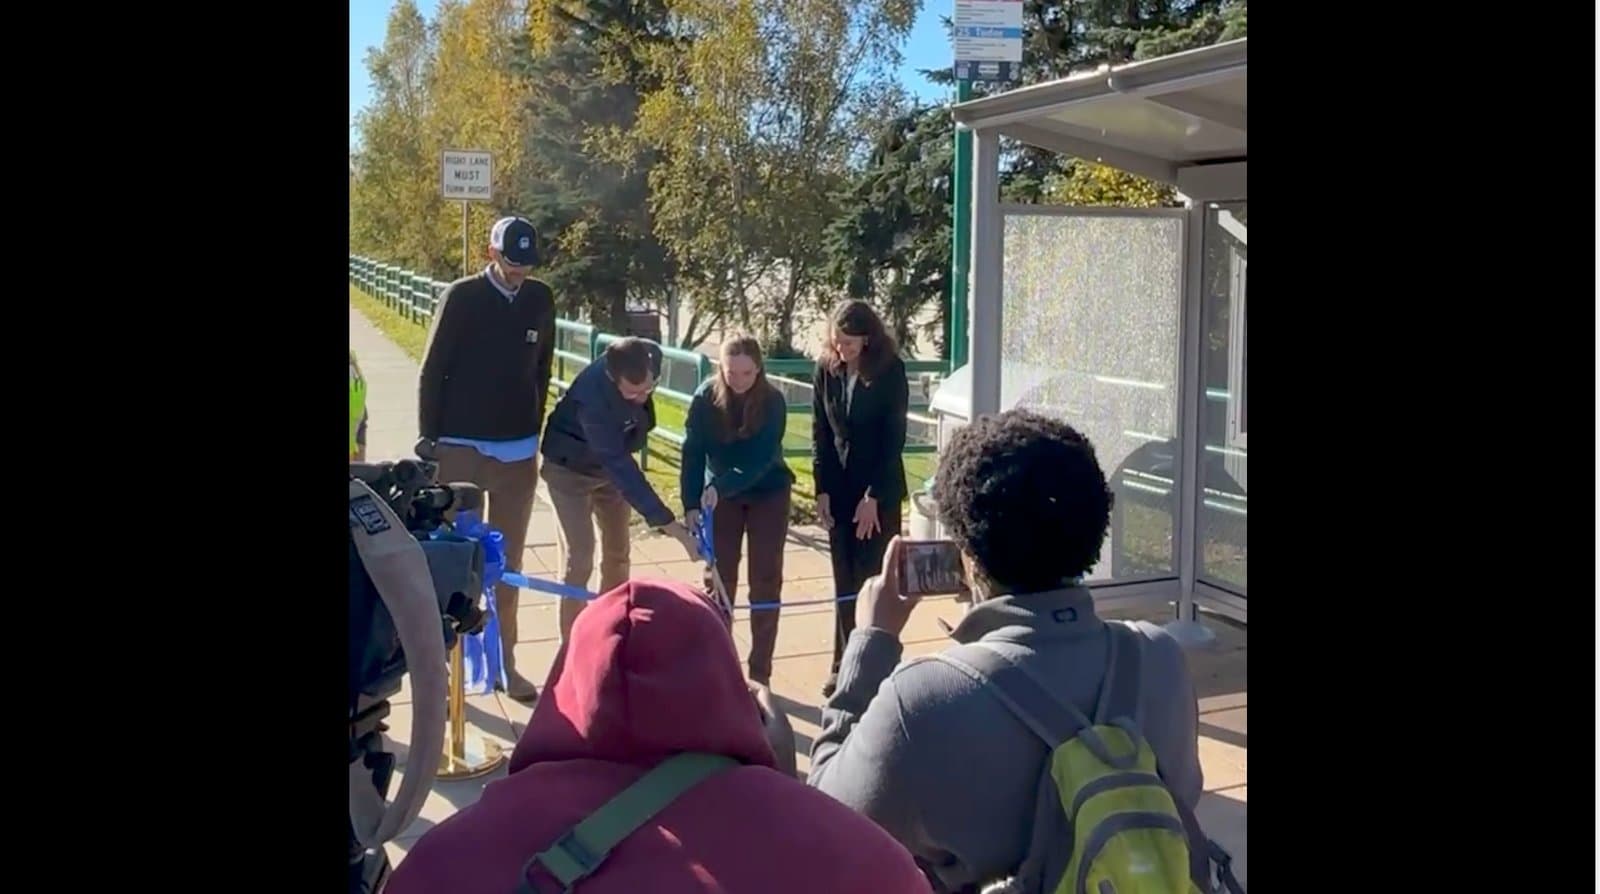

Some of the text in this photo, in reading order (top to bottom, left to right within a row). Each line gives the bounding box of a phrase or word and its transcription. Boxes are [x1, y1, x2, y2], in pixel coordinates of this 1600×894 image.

[445, 156, 489, 166] RIGHT LANE
[454, 170, 480, 180] MUST
[445, 184, 489, 194] TURN RIGHT
